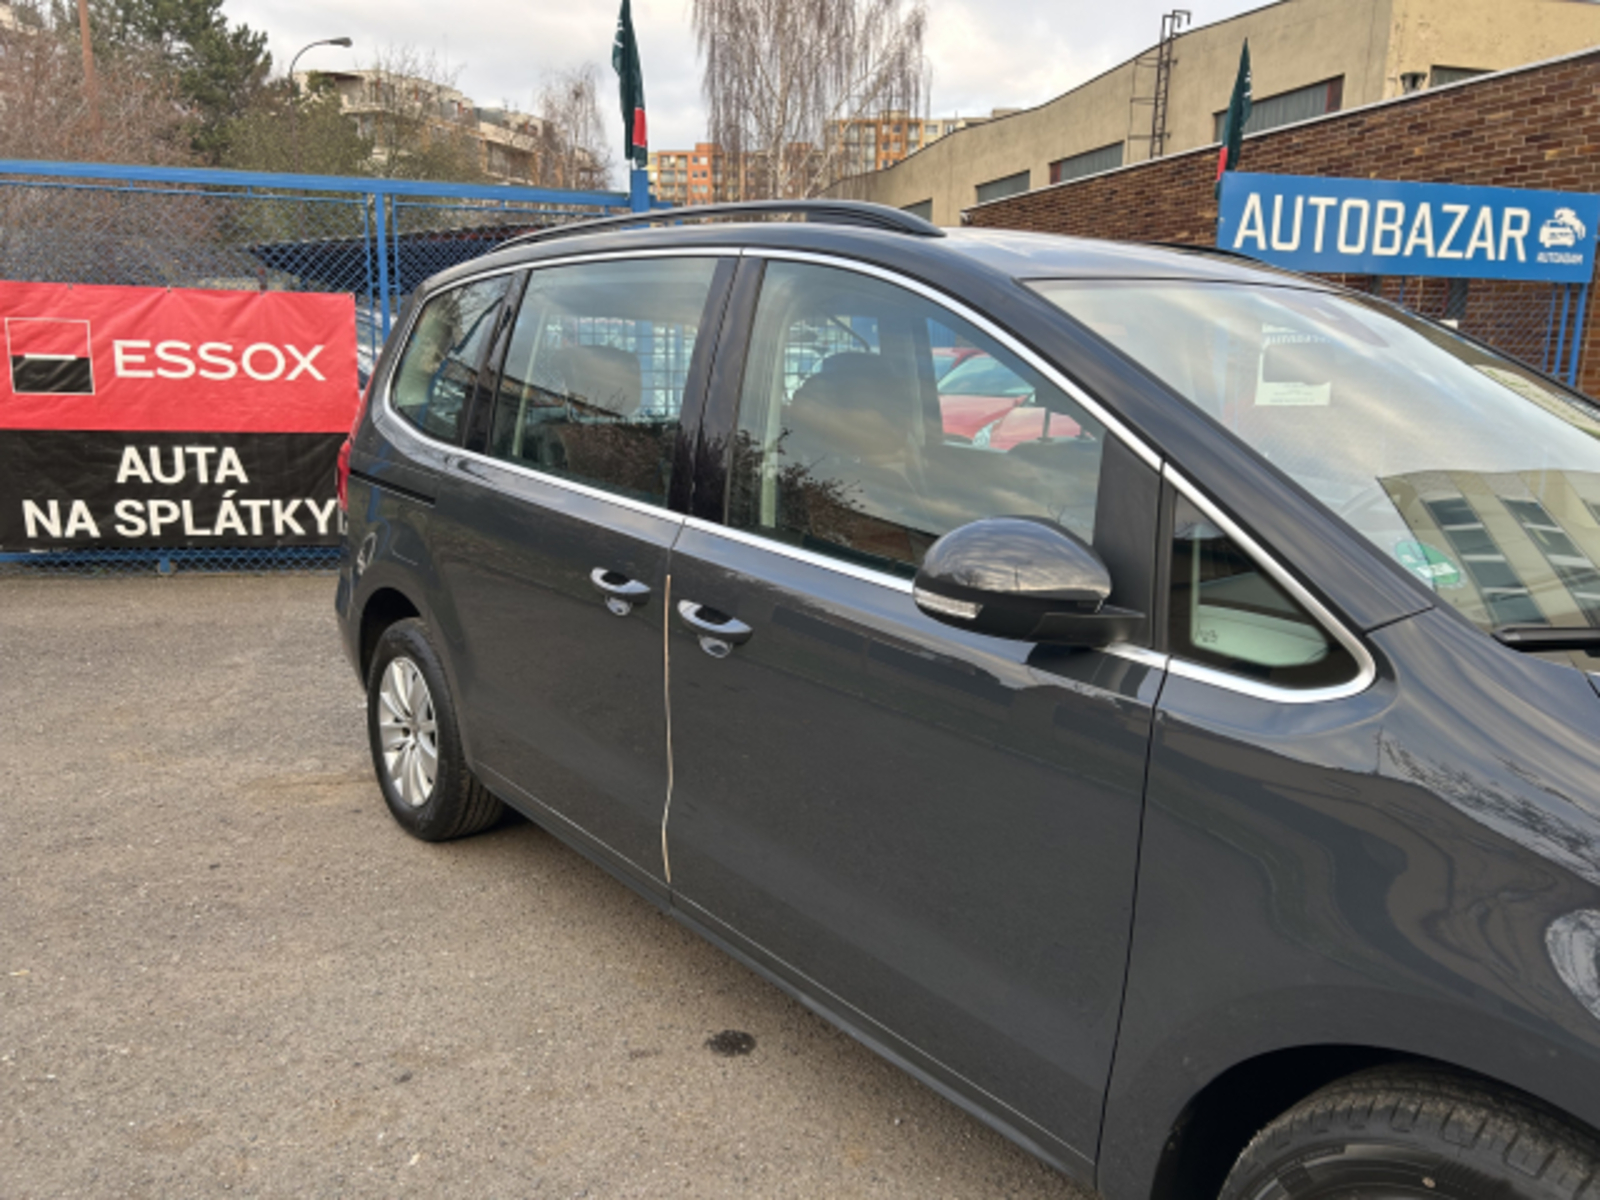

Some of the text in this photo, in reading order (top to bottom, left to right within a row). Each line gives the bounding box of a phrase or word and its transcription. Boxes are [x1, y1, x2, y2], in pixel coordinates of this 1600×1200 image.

[1233, 193, 1530, 262] AUTOBAZAR
[113, 339, 326, 381] ESSOX
[116, 446, 249, 484] AUTA
[22, 489, 337, 538] NA SPLÁTKY
